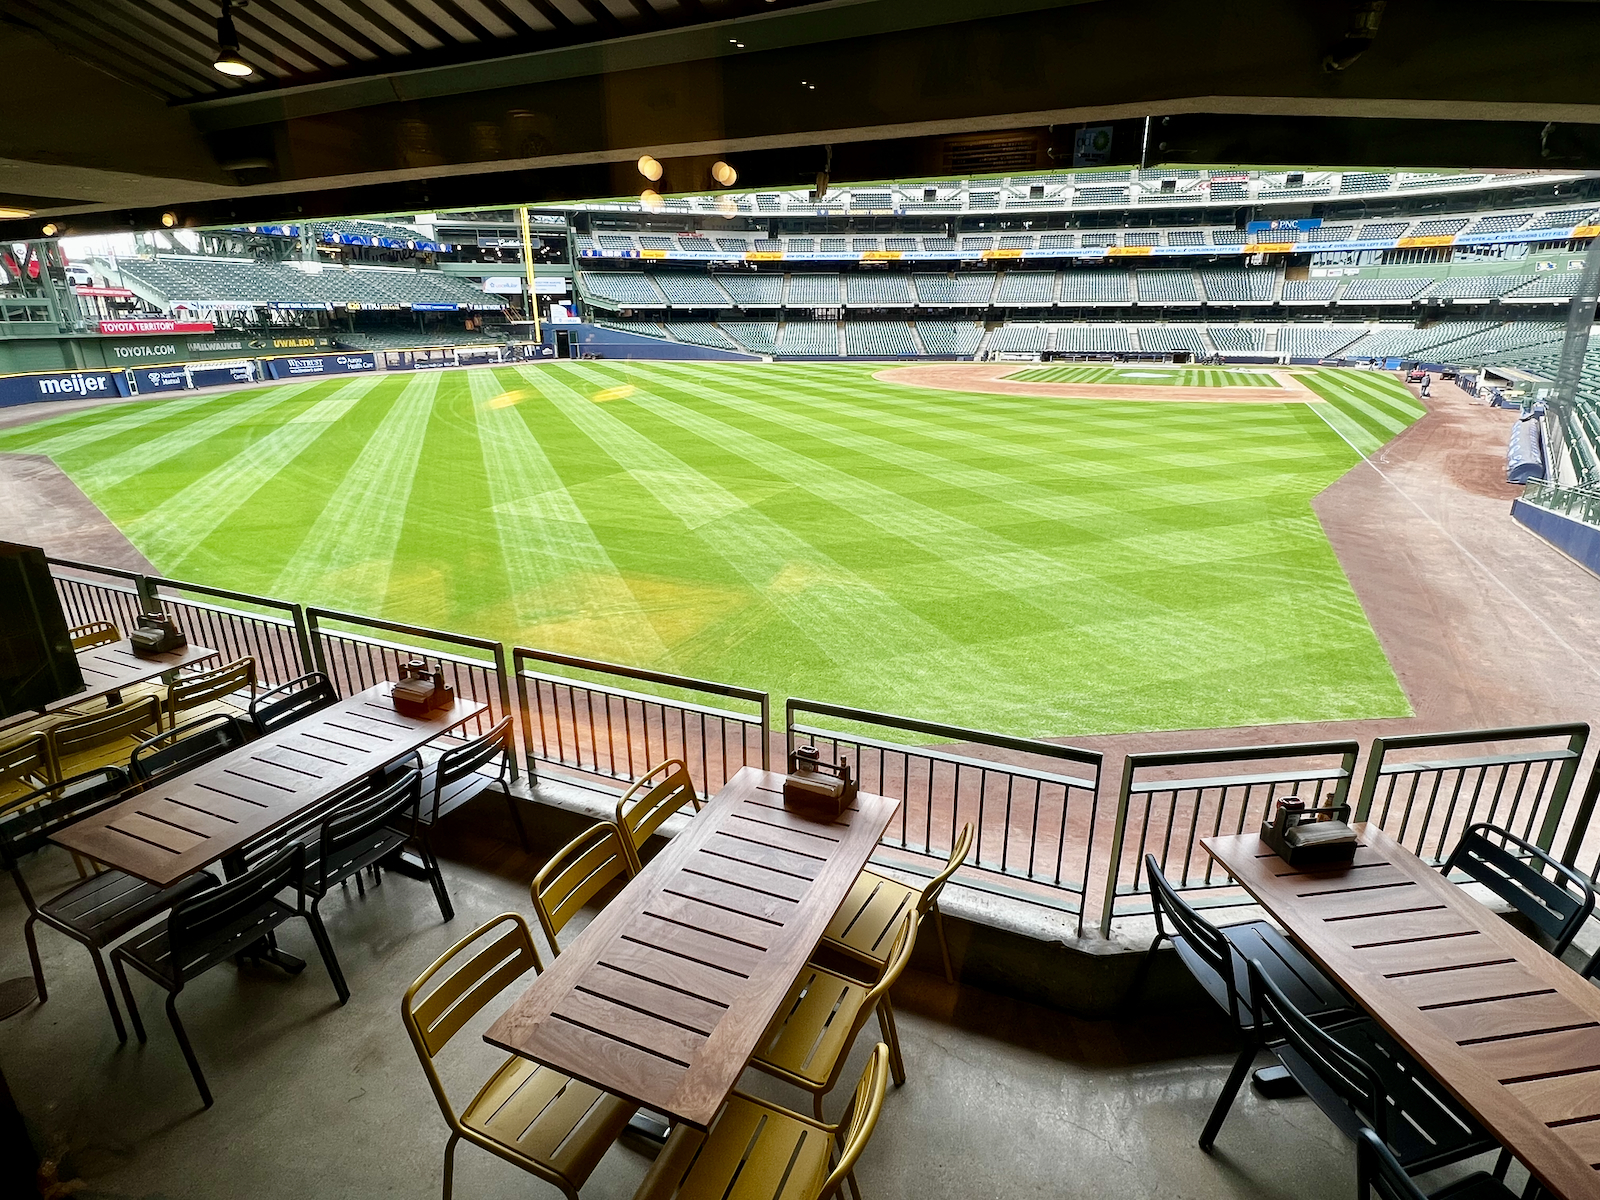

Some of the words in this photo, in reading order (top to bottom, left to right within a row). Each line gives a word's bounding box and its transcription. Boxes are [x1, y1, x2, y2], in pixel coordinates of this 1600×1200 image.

[102, 322, 134, 332] TOYOTA
[136, 322, 175, 331] TERRITORY
[274, 338, 315, 348] UWM.EDU
[113, 344, 176, 358] TOYOTA.COM
[287, 359, 323, 367] WINTRUST
[39, 374, 106, 395] meijer
